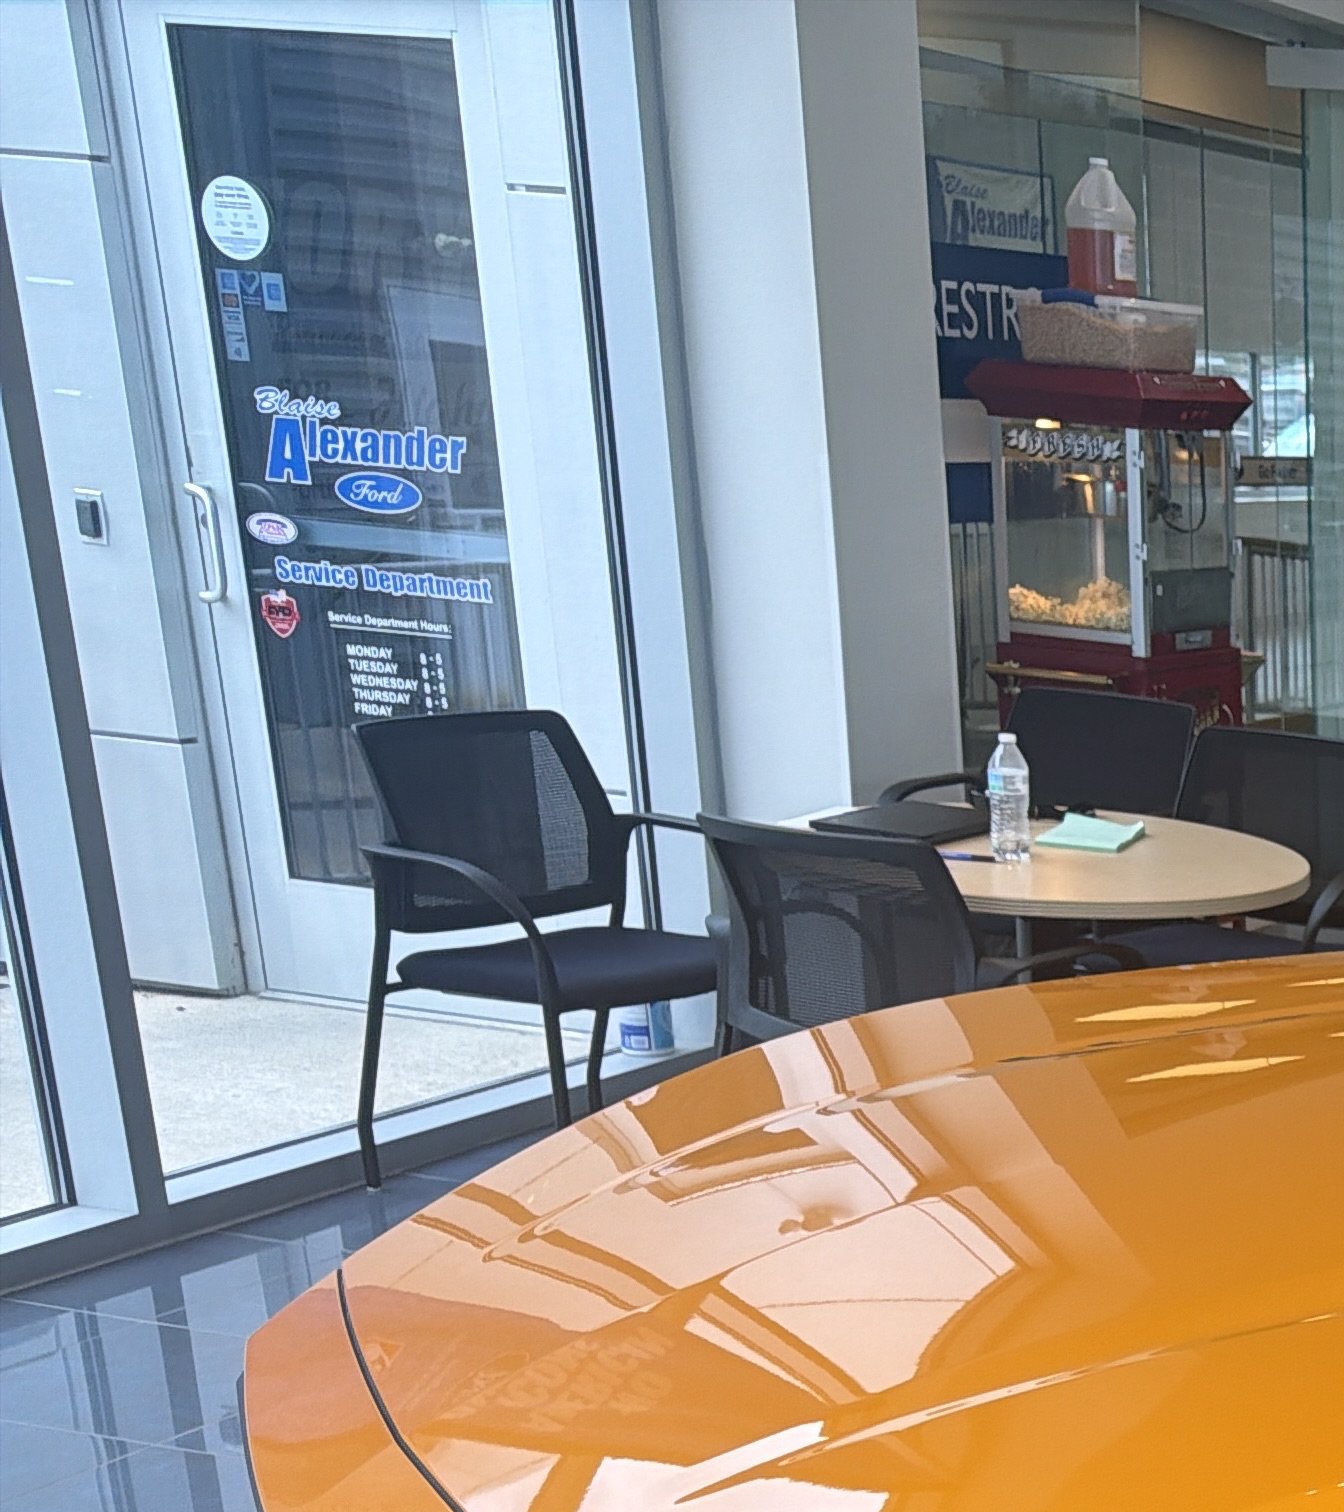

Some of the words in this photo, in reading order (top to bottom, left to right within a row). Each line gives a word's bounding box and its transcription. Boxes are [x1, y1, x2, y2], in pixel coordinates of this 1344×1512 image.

[934, 279, 1022, 341] ESTR
[254, 386, 341, 419] Blaise
[265, 415, 467, 485] Alexander
[350, 479, 404, 504] Ford
[274, 556, 358, 588] Service
[361, 564, 493, 604] Department
[327, 610, 362, 624] Service
[364, 614, 418, 630] Department
[420, 619, 452, 633] Hours:
[346, 643, 392, 660] MONDAY
[348, 658, 398, 674] TUESDAY
[350, 673, 418, 691] WEDNESDAY
[352, 687, 410, 704] THURSDAY
[354, 702, 392, 717] FRIDAY
